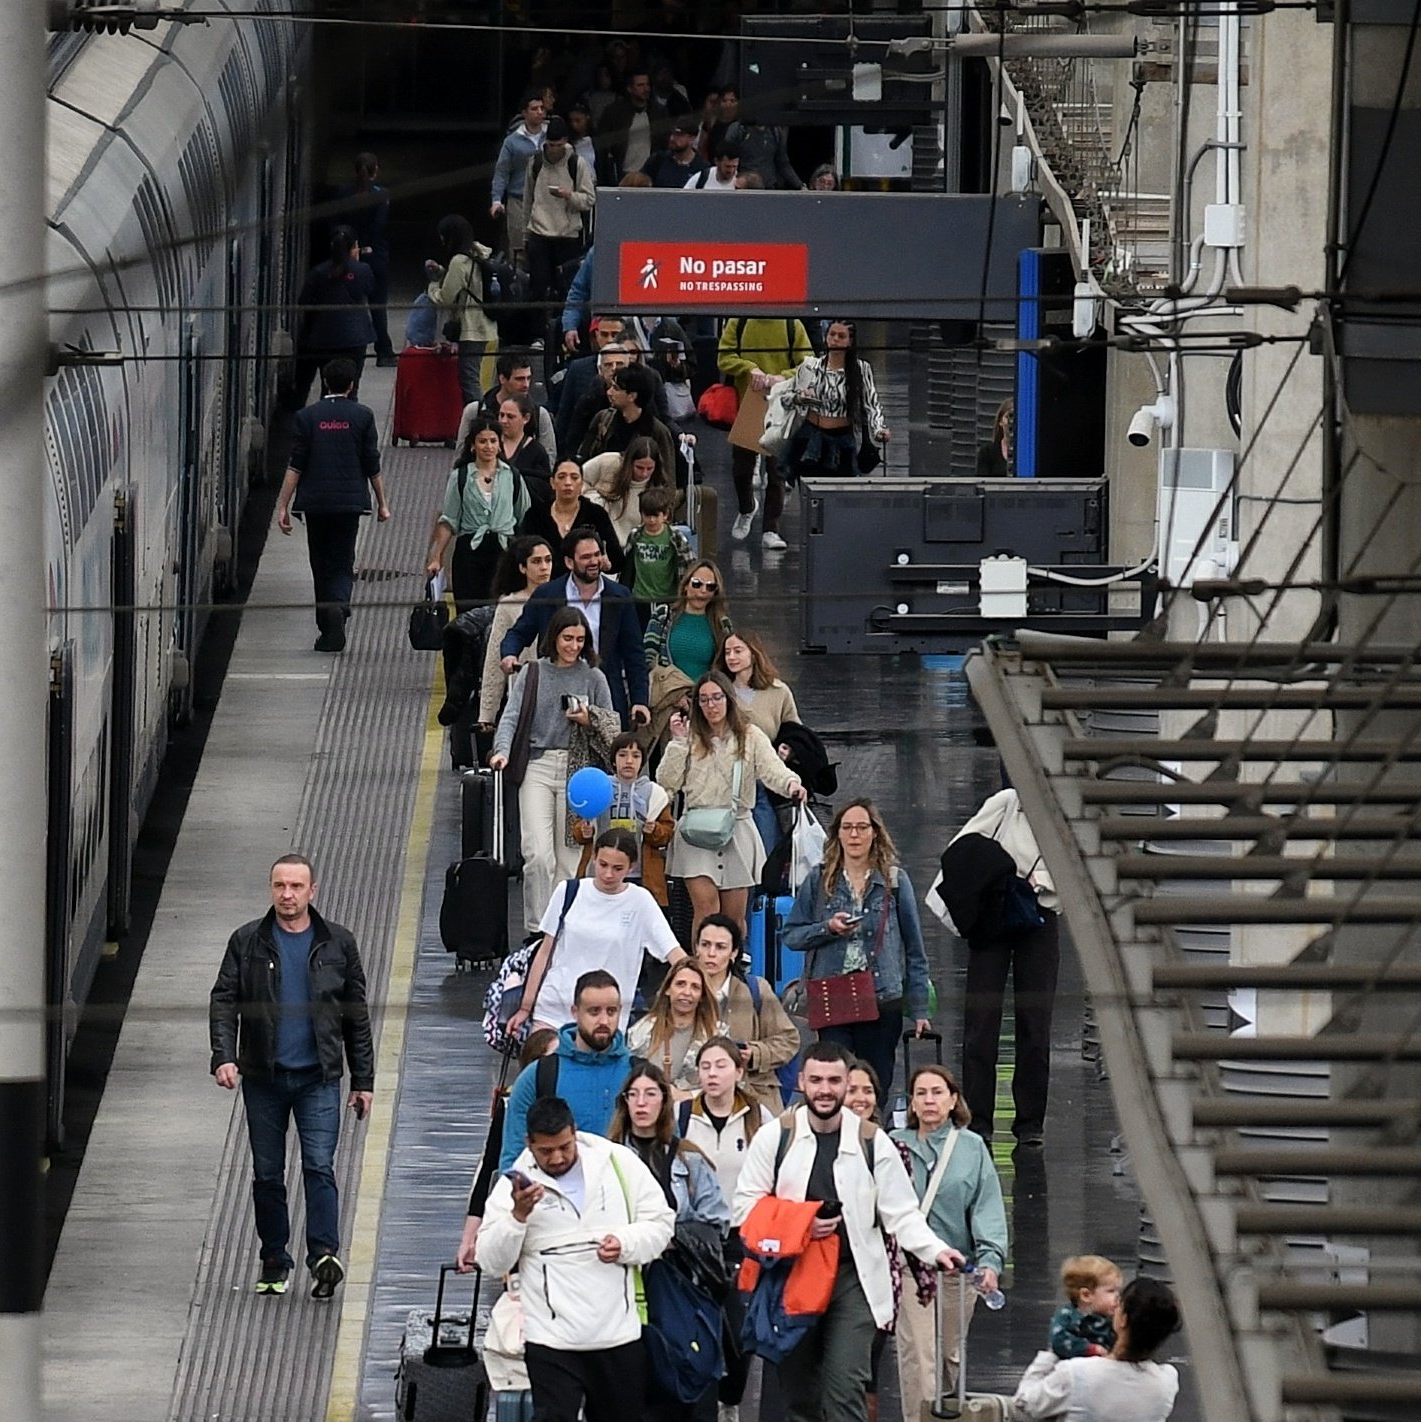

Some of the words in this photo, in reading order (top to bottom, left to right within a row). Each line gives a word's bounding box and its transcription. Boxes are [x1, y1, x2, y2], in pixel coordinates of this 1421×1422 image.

[680, 256, 706, 274] No
[712, 259, 767, 279] pasar
[680, 281, 694, 291] NO
[696, 281, 763, 292] TRESPASSING
